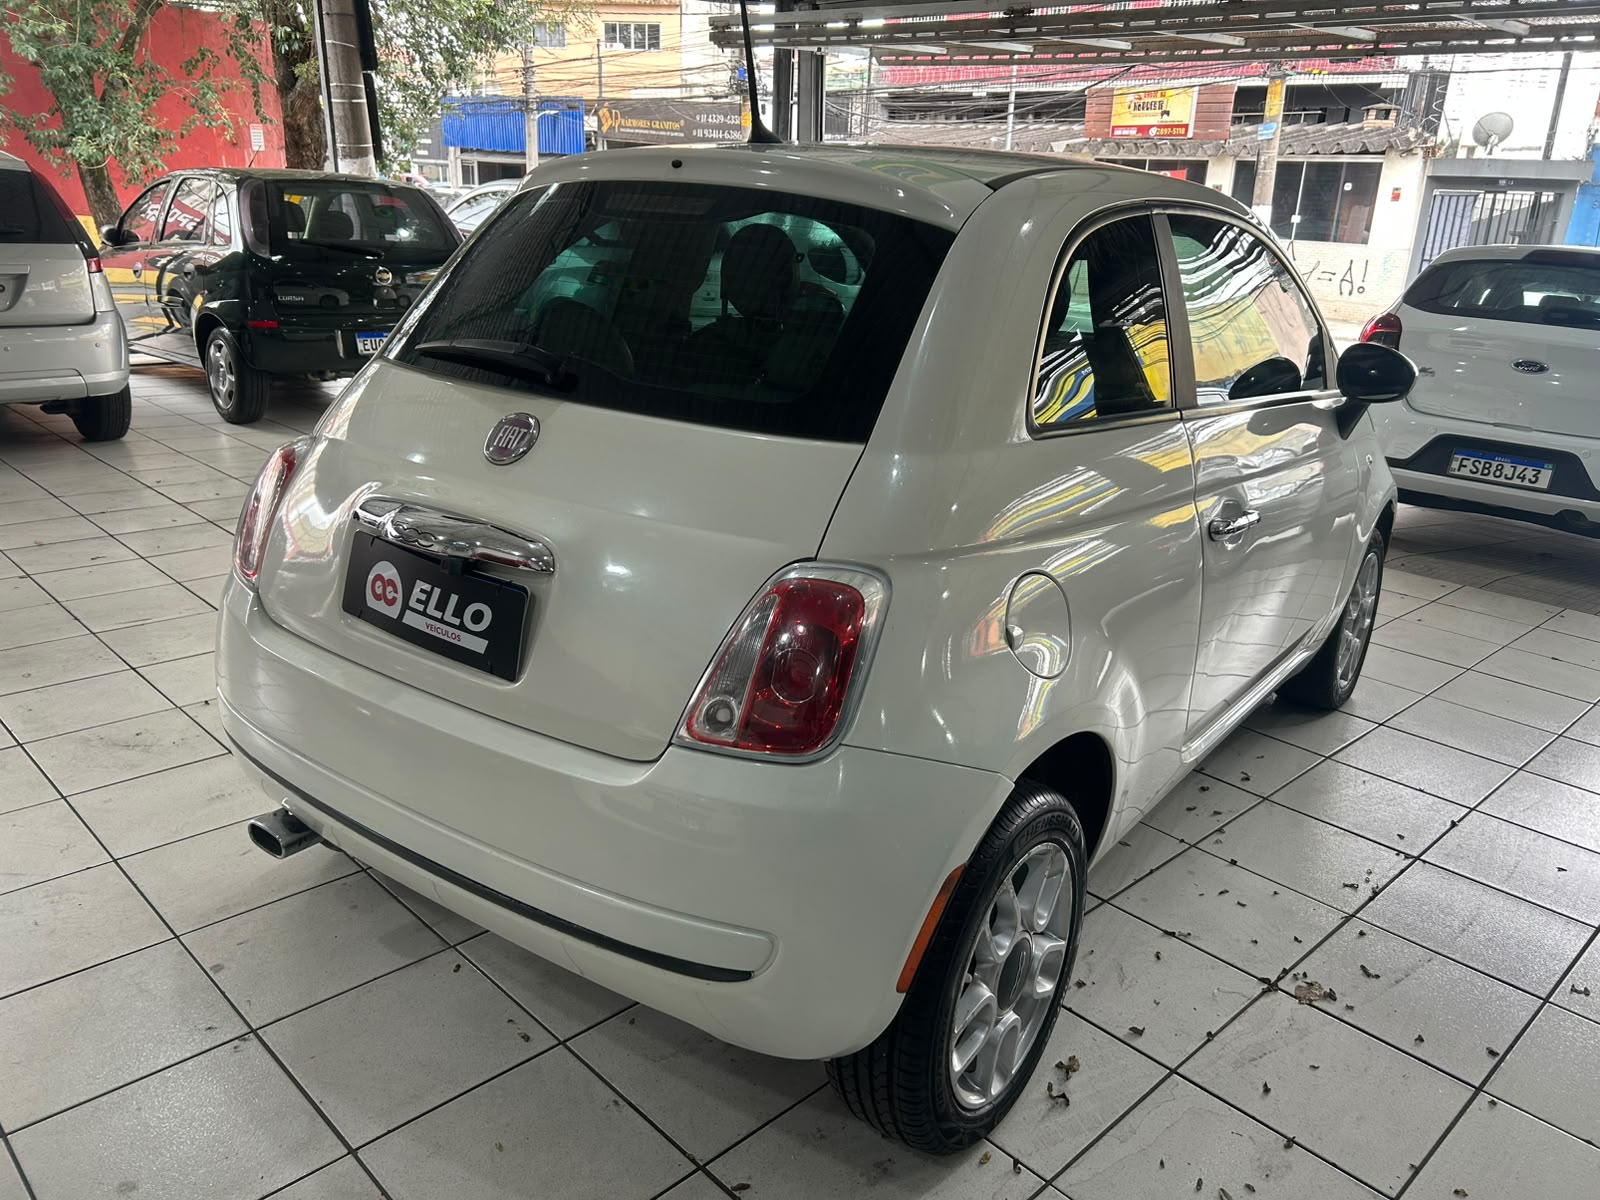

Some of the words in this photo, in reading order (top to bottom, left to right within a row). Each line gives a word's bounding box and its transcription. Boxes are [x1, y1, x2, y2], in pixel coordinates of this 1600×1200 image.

[493, 425, 528, 449] FIAT
[1457, 457, 1541, 484] FSB8J43
[408, 579, 493, 632] ELLO
